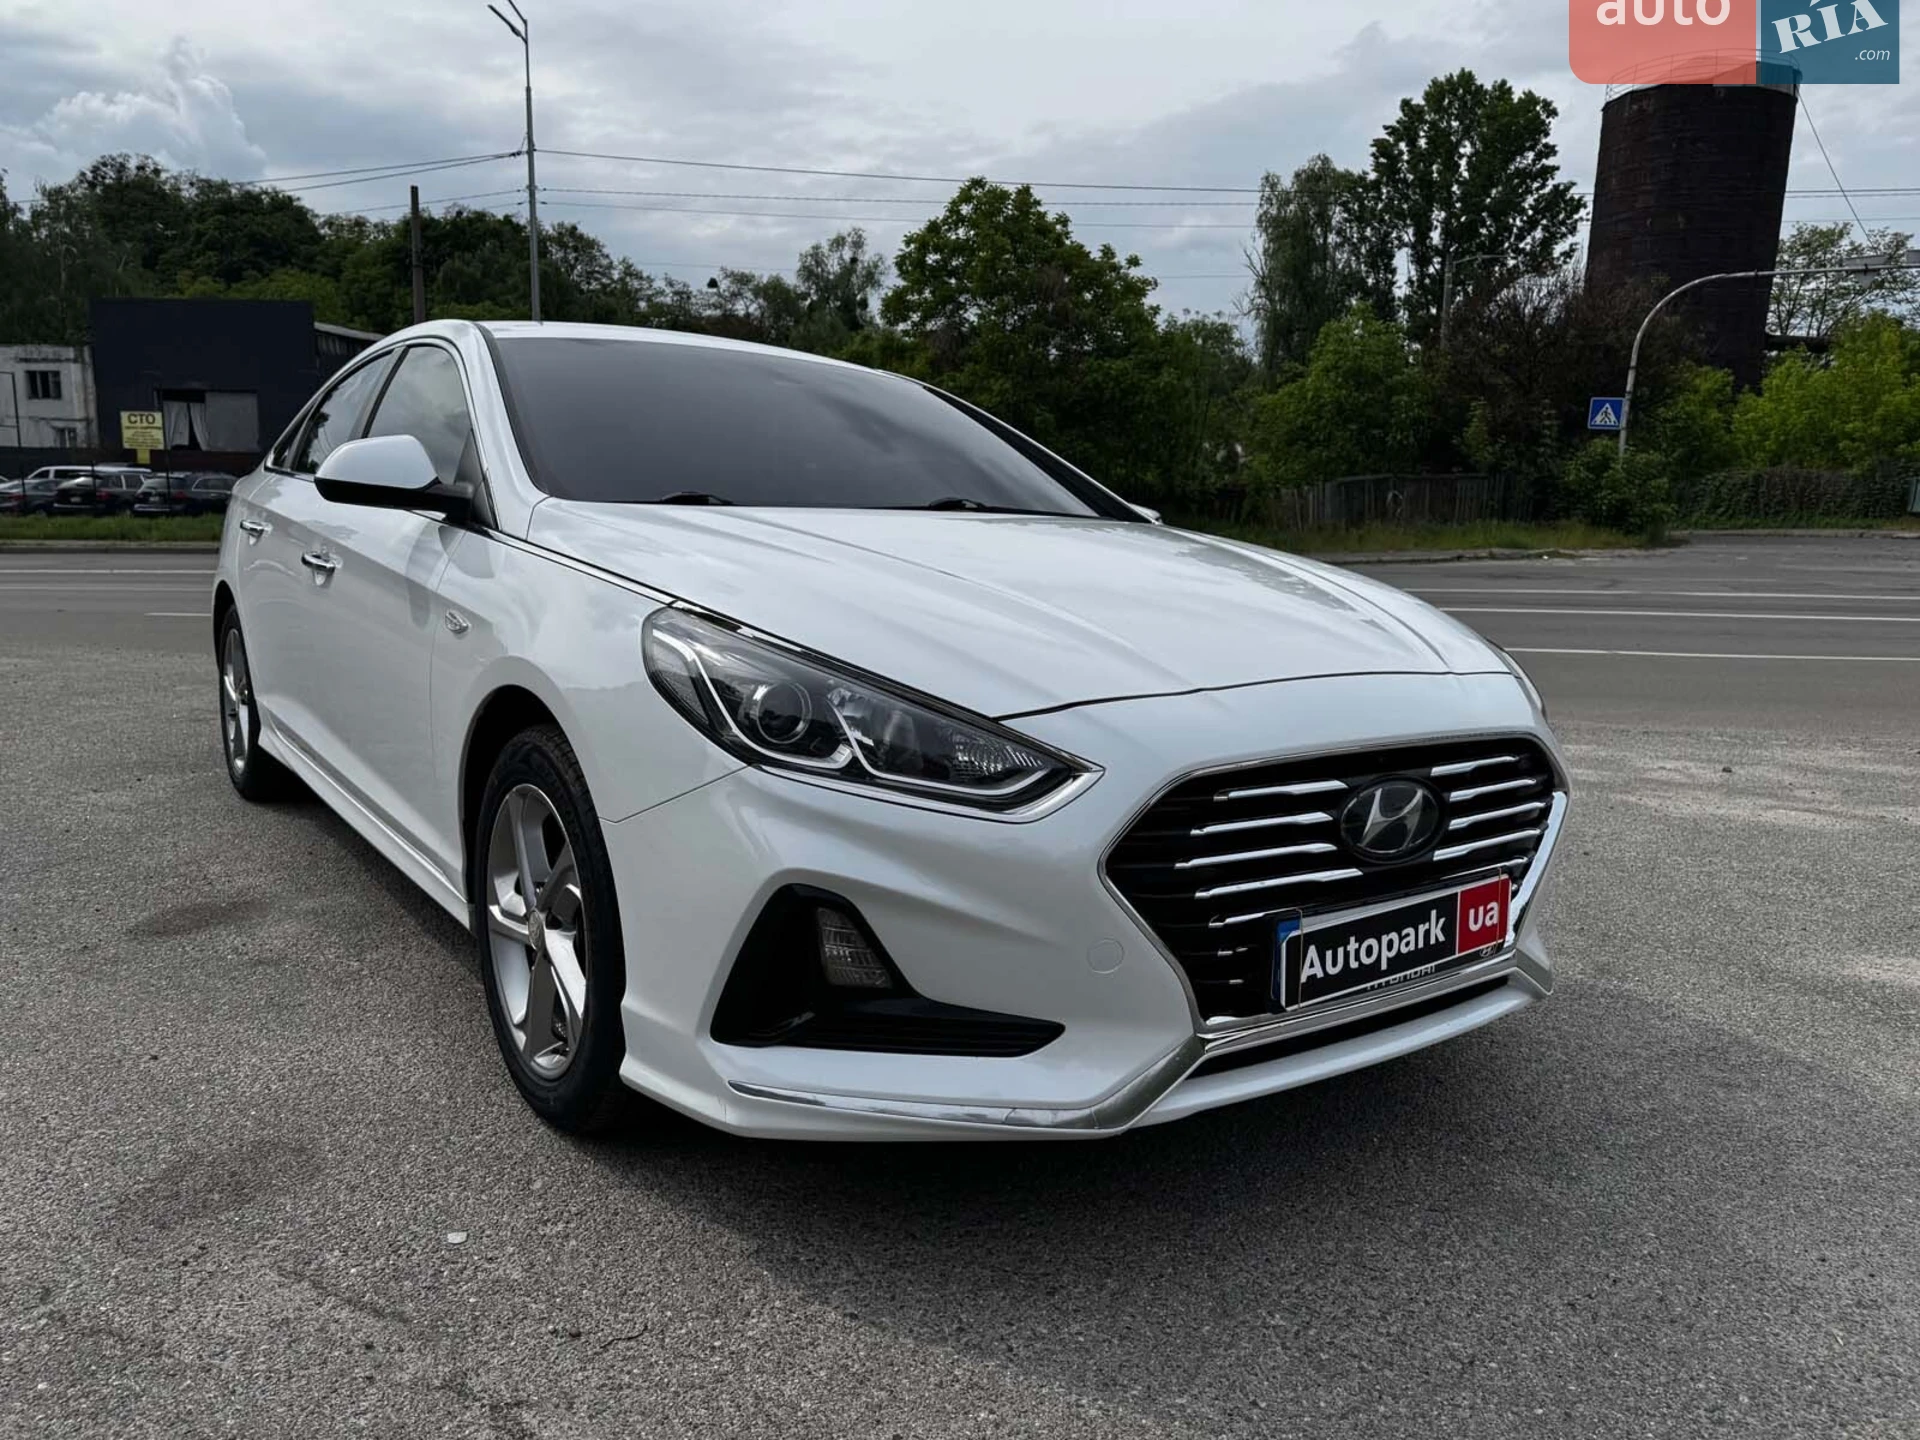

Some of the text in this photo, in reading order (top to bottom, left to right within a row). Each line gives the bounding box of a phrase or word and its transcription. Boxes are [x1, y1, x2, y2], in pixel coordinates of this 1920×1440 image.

[127, 413, 156, 425] СТО
[1301, 901, 1499, 983] Autopark ua
